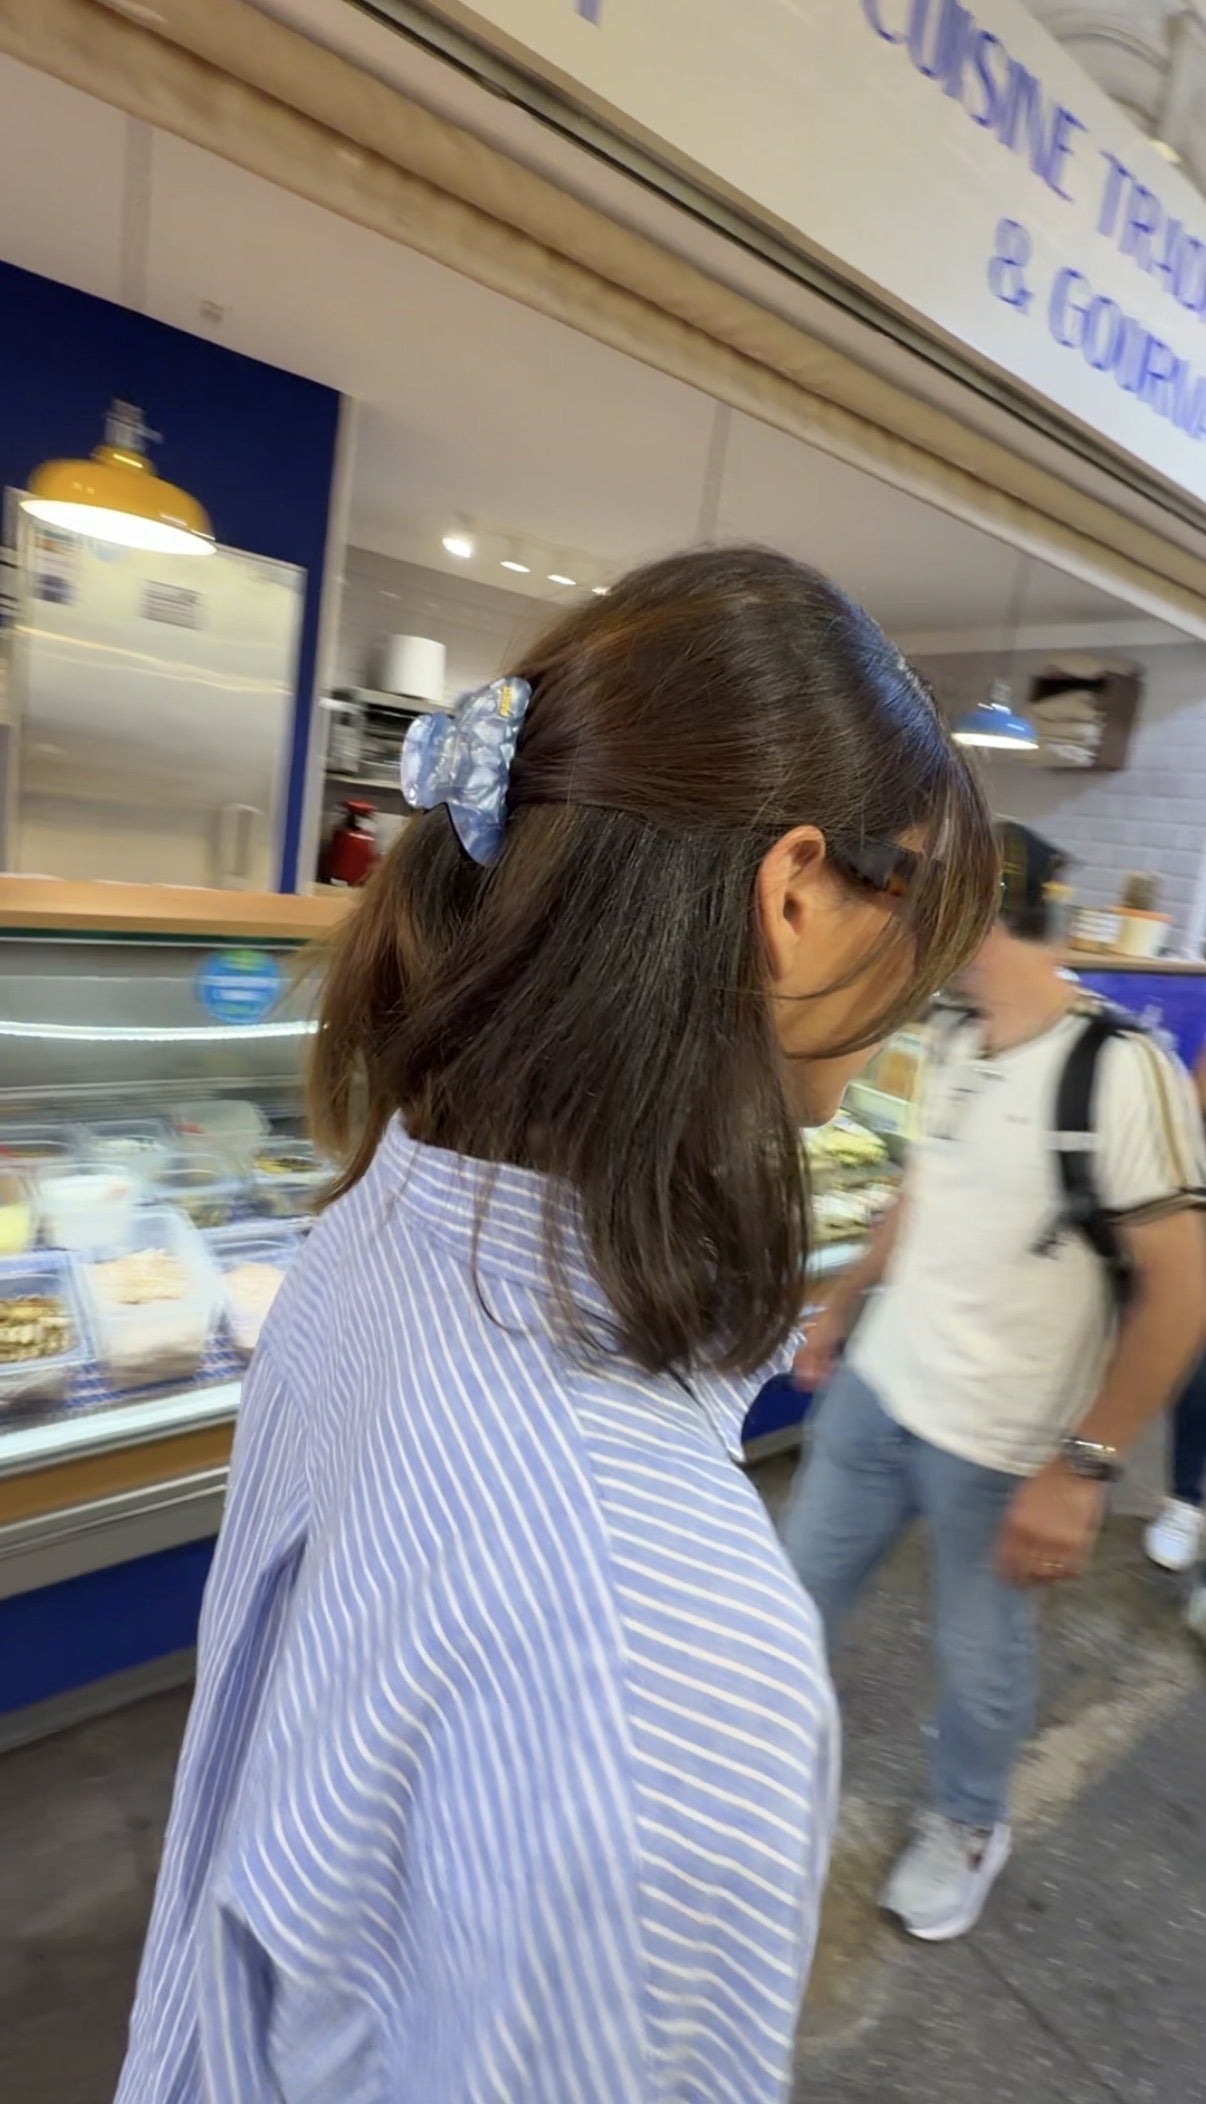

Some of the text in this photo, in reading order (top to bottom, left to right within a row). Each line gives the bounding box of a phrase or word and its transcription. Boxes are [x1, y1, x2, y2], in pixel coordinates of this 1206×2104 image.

[986, 217, 1206, 442] & GOURM
[1097, 149, 1206, 325] TRAD
